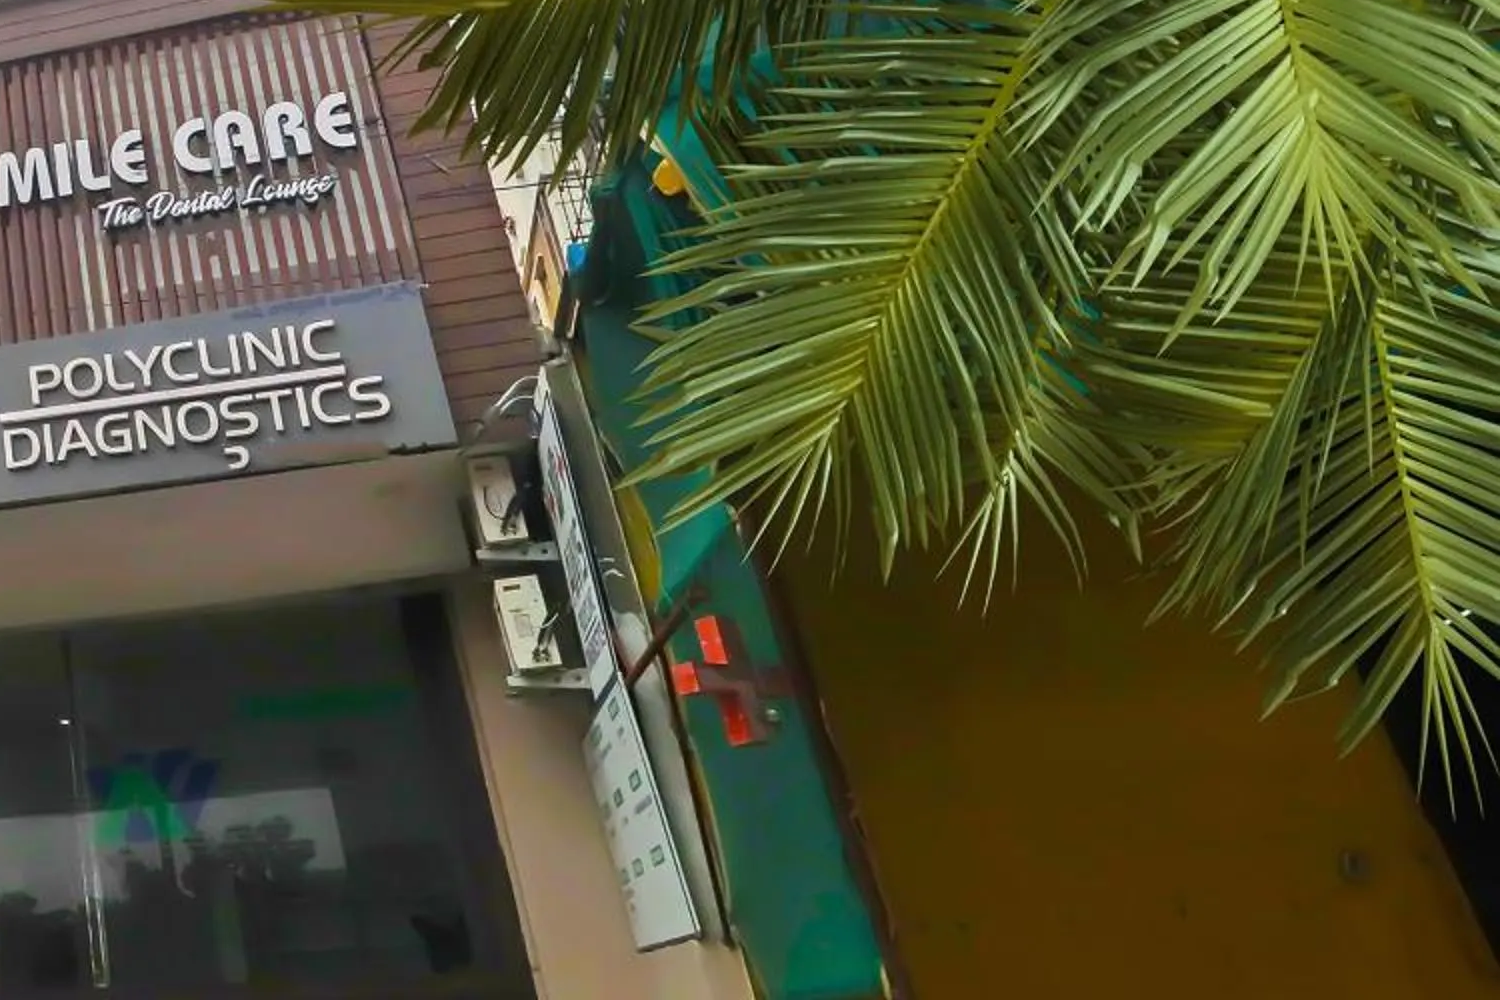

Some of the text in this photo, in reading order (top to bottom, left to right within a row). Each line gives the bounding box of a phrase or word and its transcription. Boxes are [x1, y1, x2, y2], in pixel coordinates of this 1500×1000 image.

[174, 91, 358, 173] CARE
[98, 173, 336, 231] The Dental Lounge
[28, 319, 342, 406] POLYCLINIC
[2, 375, 392, 471] DIAGNOSTICS
